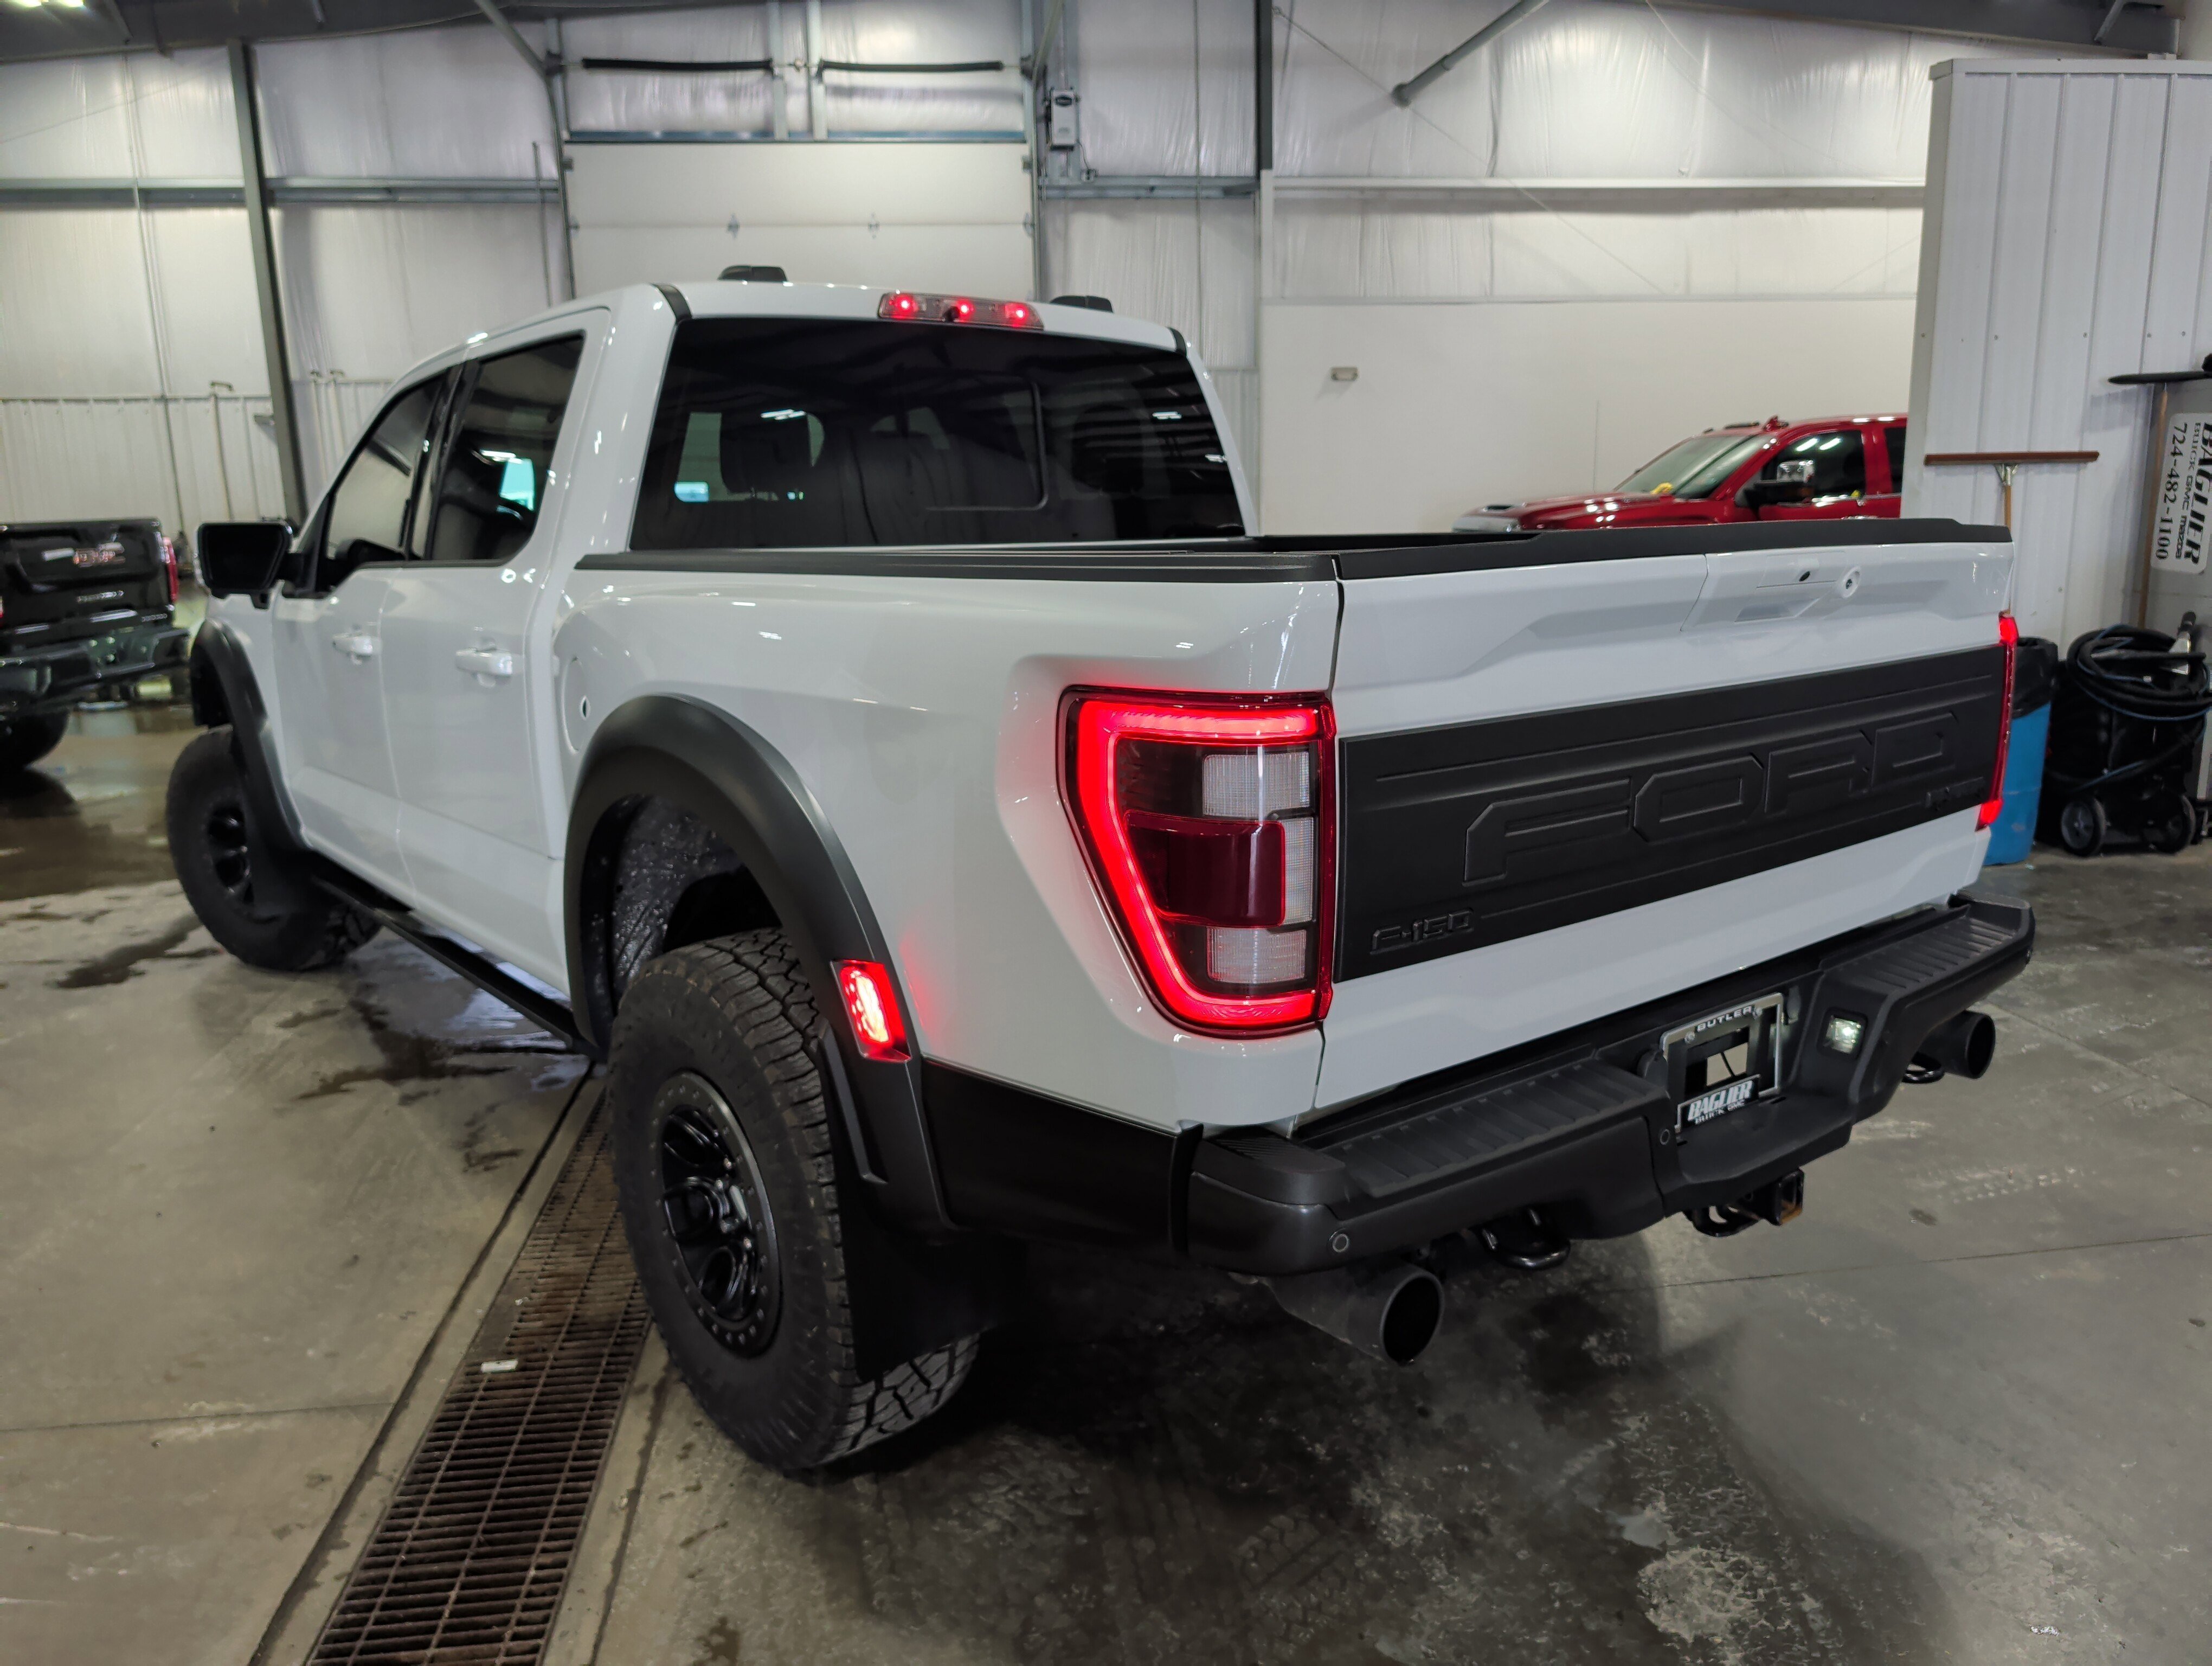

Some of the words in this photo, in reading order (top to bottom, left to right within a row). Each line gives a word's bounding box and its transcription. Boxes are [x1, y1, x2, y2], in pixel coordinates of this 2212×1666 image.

[2187, 422, 2201, 470] BUICK
[2155, 422, 2188, 560] 724-482-1100
[2182, 475, 2193, 511] GMC
[1464, 712, 1958, 887] FORD
[1370, 908, 1475, 956] F-150
[1697, 1005, 1752, 1032] BUTLER
[1687, 1080, 1754, 1122] BAGLIER
